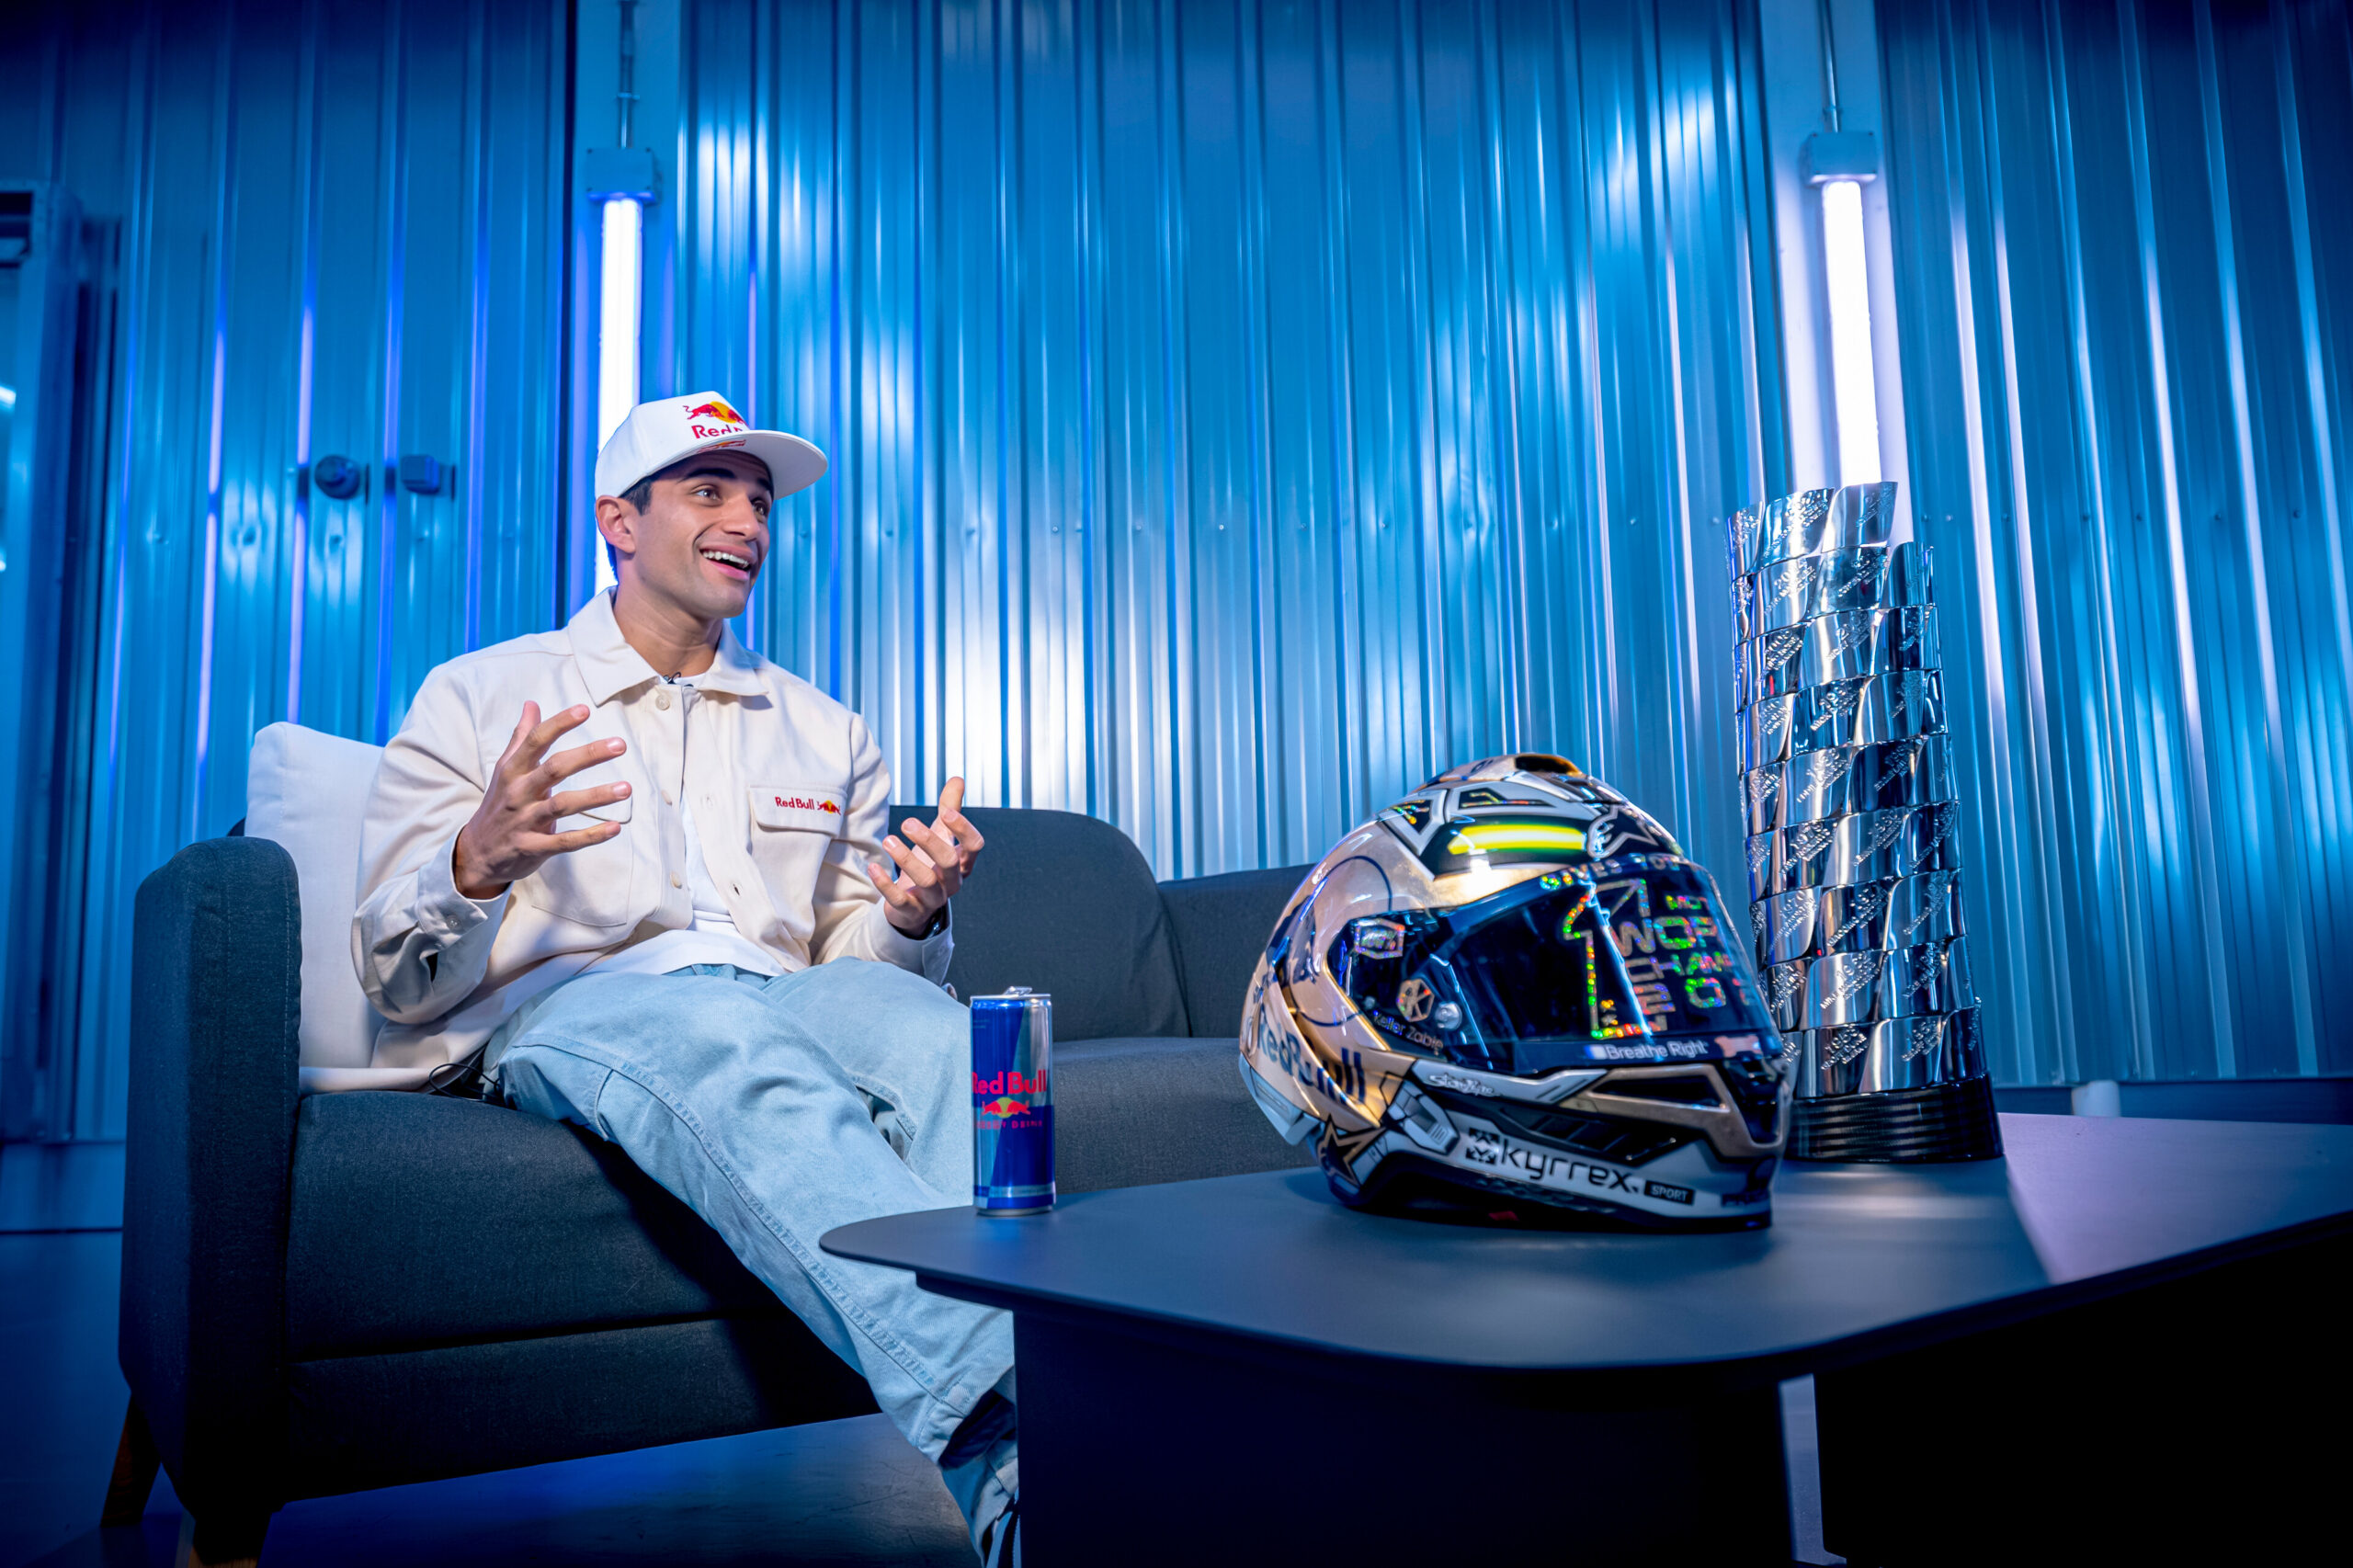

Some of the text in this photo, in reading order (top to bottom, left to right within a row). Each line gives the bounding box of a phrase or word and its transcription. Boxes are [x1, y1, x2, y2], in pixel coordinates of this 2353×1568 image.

[775, 797, 814, 810] Red Bull
[1607, 1040, 1709, 1059] Breathe Right
[1007, 1069, 1046, 1095] Bull
[1500, 1138, 1632, 1194] kyrrex
[1651, 1184, 1688, 1202] SPORT
